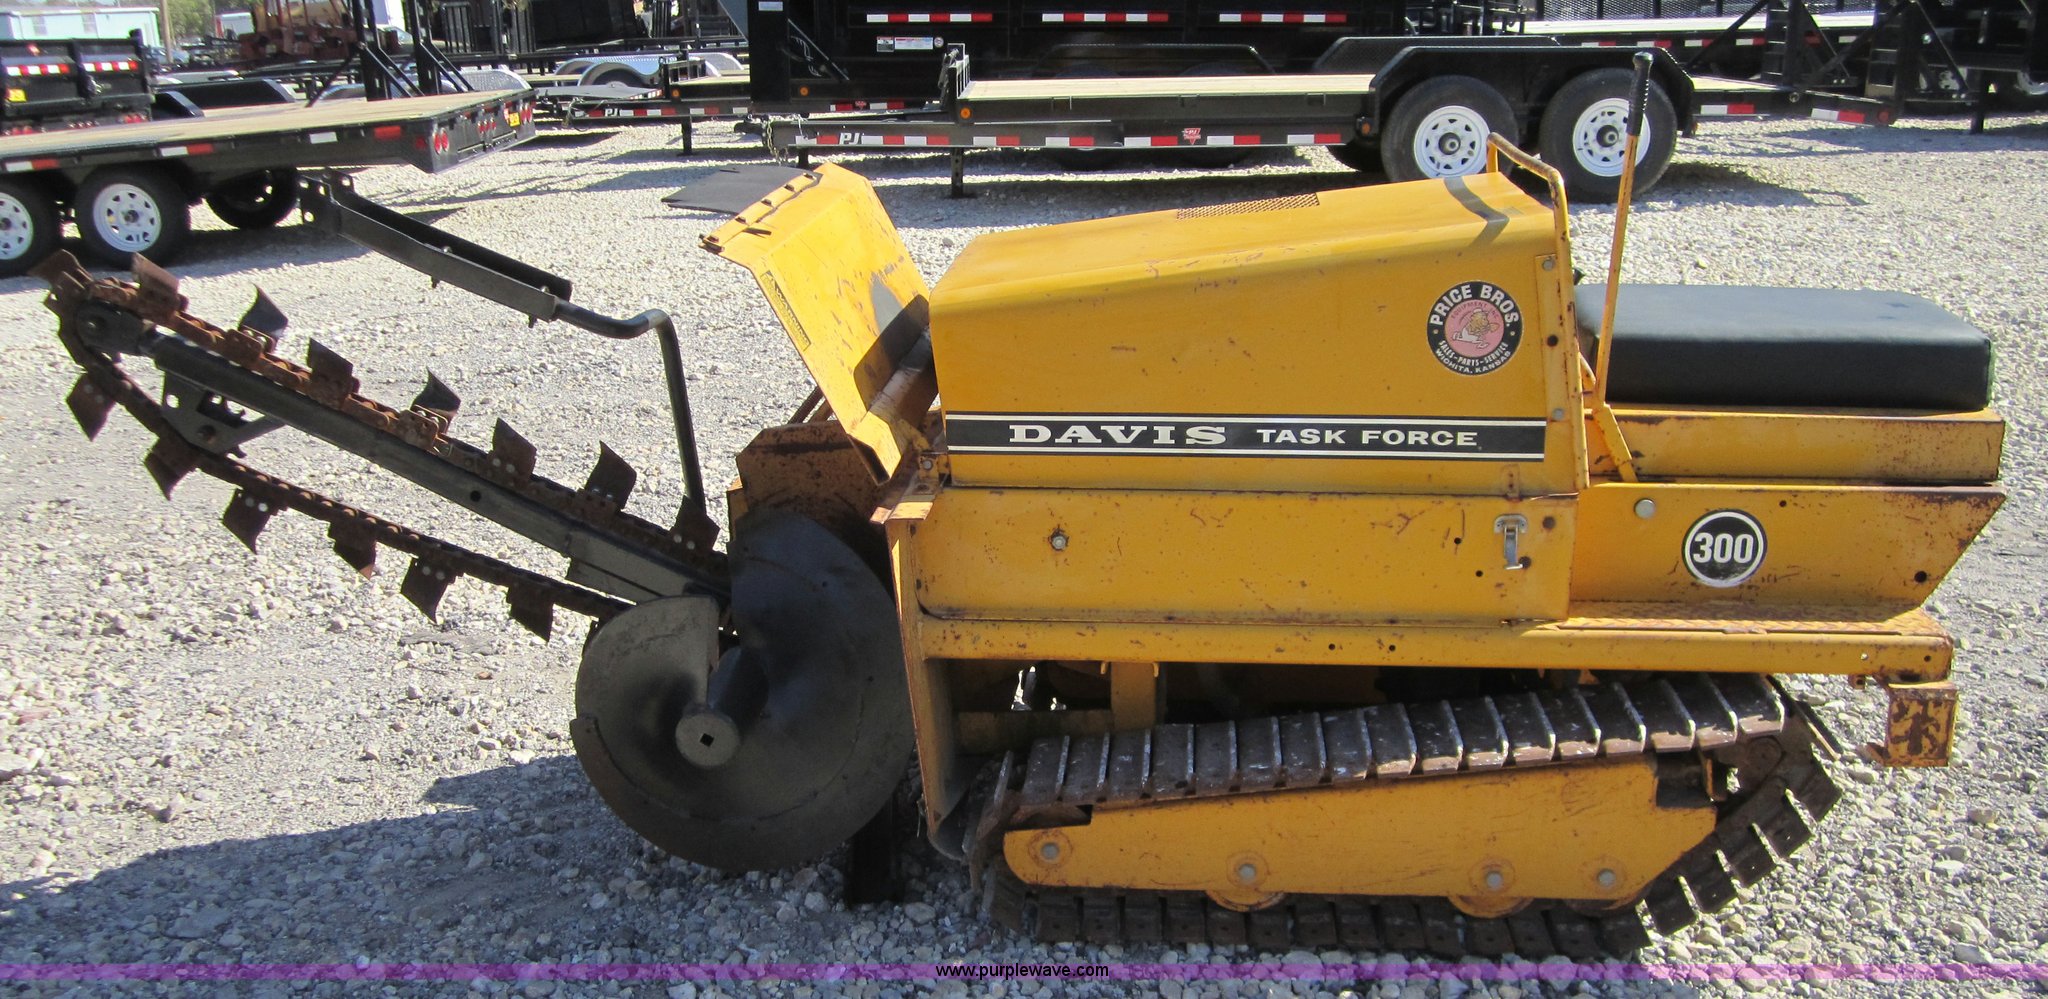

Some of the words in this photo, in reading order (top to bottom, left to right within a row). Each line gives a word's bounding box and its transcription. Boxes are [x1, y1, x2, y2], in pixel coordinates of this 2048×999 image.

[839, 132, 860, 145] PJ
[1430, 284, 1473, 326] PRICE
[1480, 284, 1520, 327] BROS.
[1475, 350, 1512, 373] KANSAS
[1009, 424, 1227, 445] DAVIS
[1256, 428, 1347, 445] TASK
[1361, 429, 1478, 446] FORCE
[1692, 532, 1754, 564] 300
